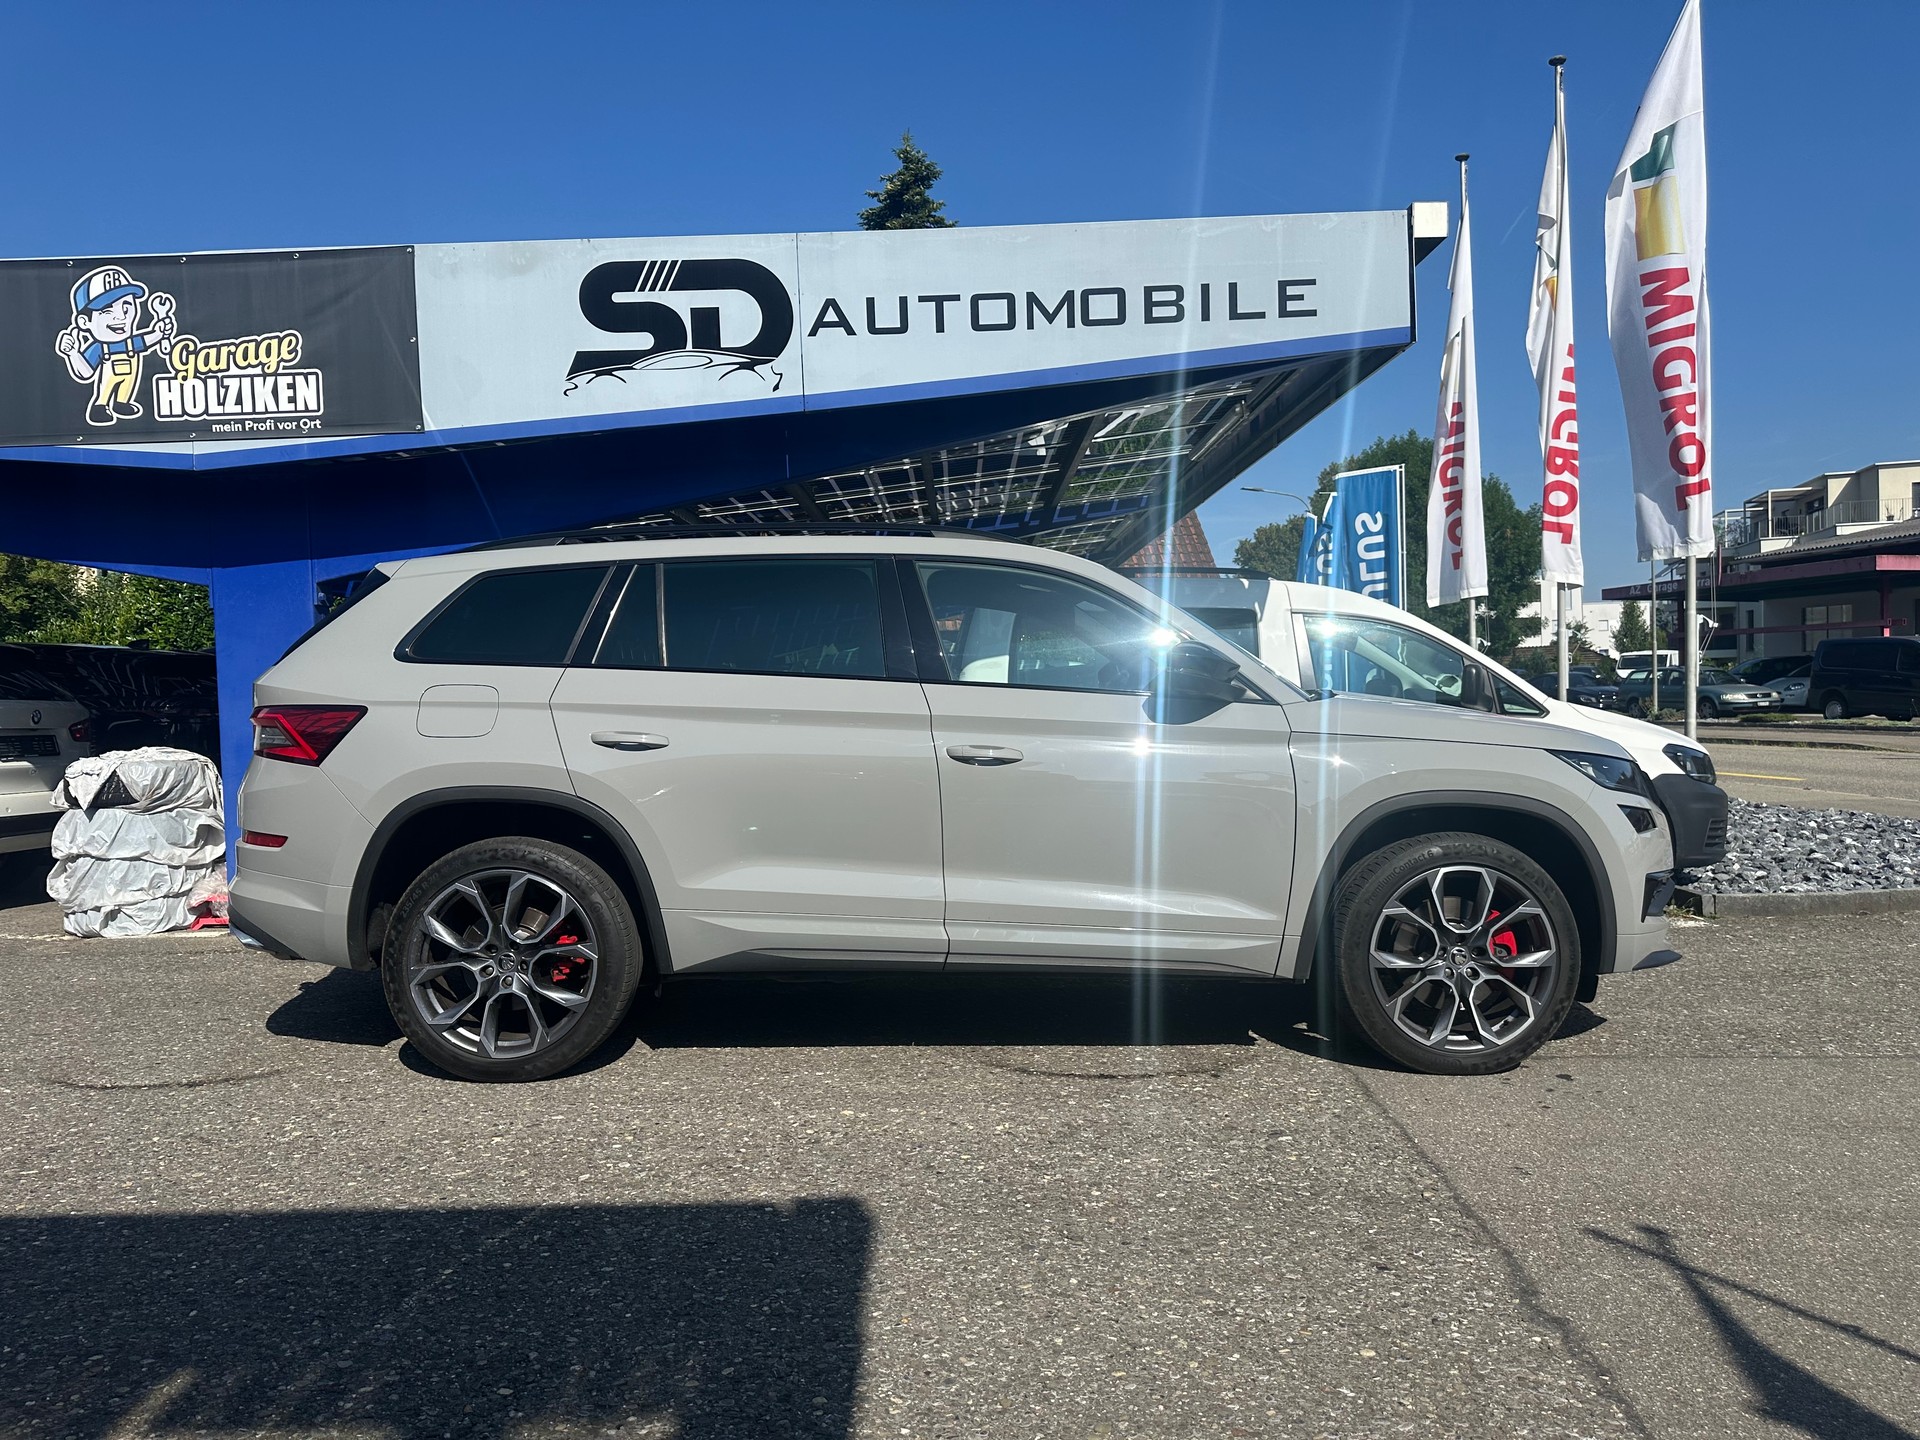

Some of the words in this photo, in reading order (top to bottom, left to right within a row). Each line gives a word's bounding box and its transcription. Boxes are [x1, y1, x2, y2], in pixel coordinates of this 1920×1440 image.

[103, 272, 121, 291] GB
[566, 258, 794, 378] SD
[808, 278, 1318, 337] AUTOMOBILE
[171, 334, 297, 384] Garage
[158, 374, 318, 416] HOLZIKEN
[1639, 267, 1711, 511] MIGROL
[212, 421, 242, 433] mein
[245, 419, 274, 431] Profi
[277, 421, 297, 430] vor
[300, 418, 321, 429] Ort
[1629, 587, 1641, 595] AZ
[1647, 582, 1678, 593] Grage
[1364, 853, 1428, 905] PremiumContact
[1427, 849, 1434, 858] 6
